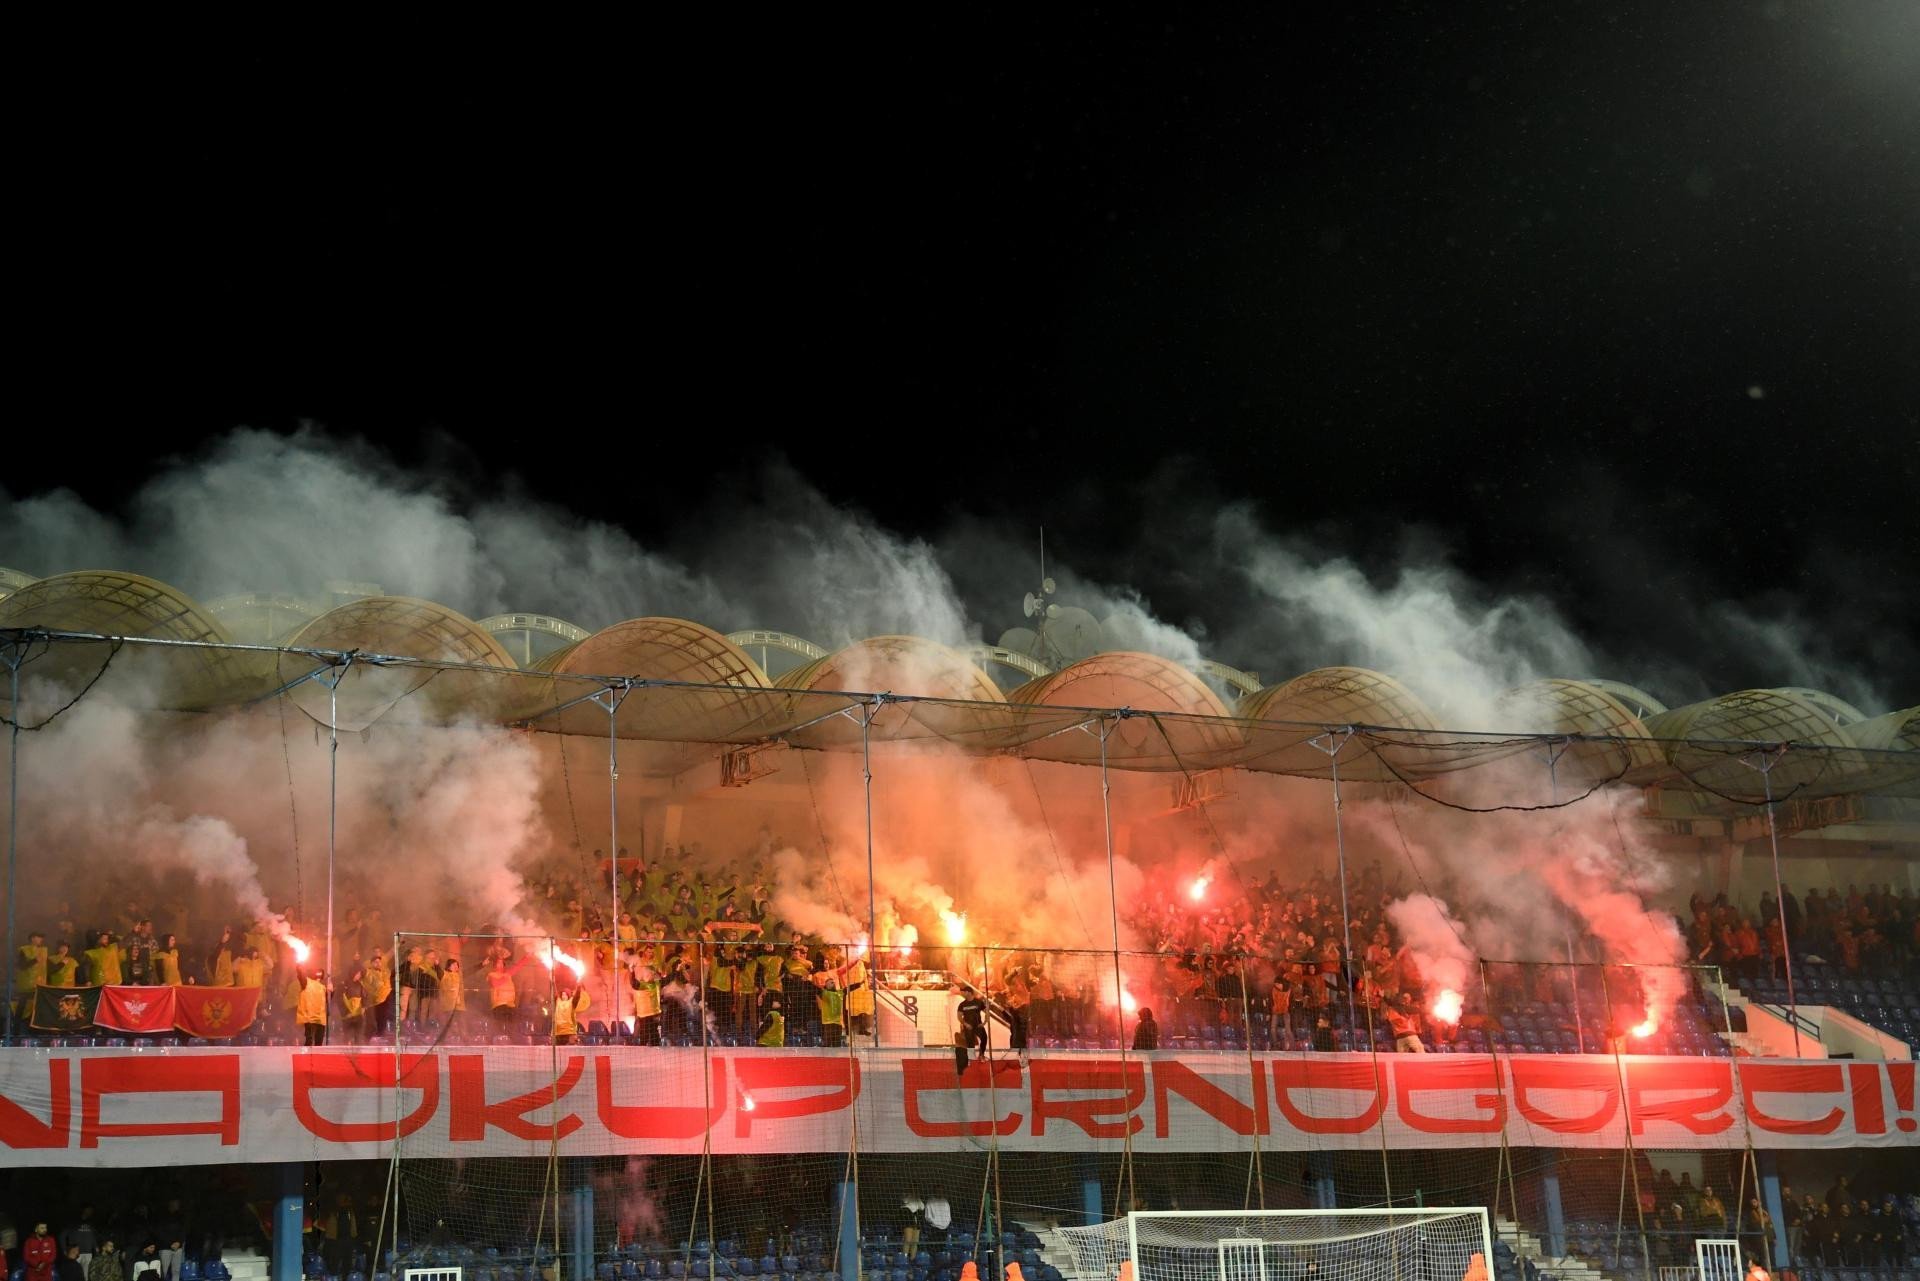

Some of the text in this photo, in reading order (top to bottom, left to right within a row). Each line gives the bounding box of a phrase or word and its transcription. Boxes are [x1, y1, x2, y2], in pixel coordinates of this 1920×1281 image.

[904, 996, 918, 1015] B
[292, 1053, 861, 1142] OKUP
[902, 1058, 1918, 1138] CRNOGORCI!
